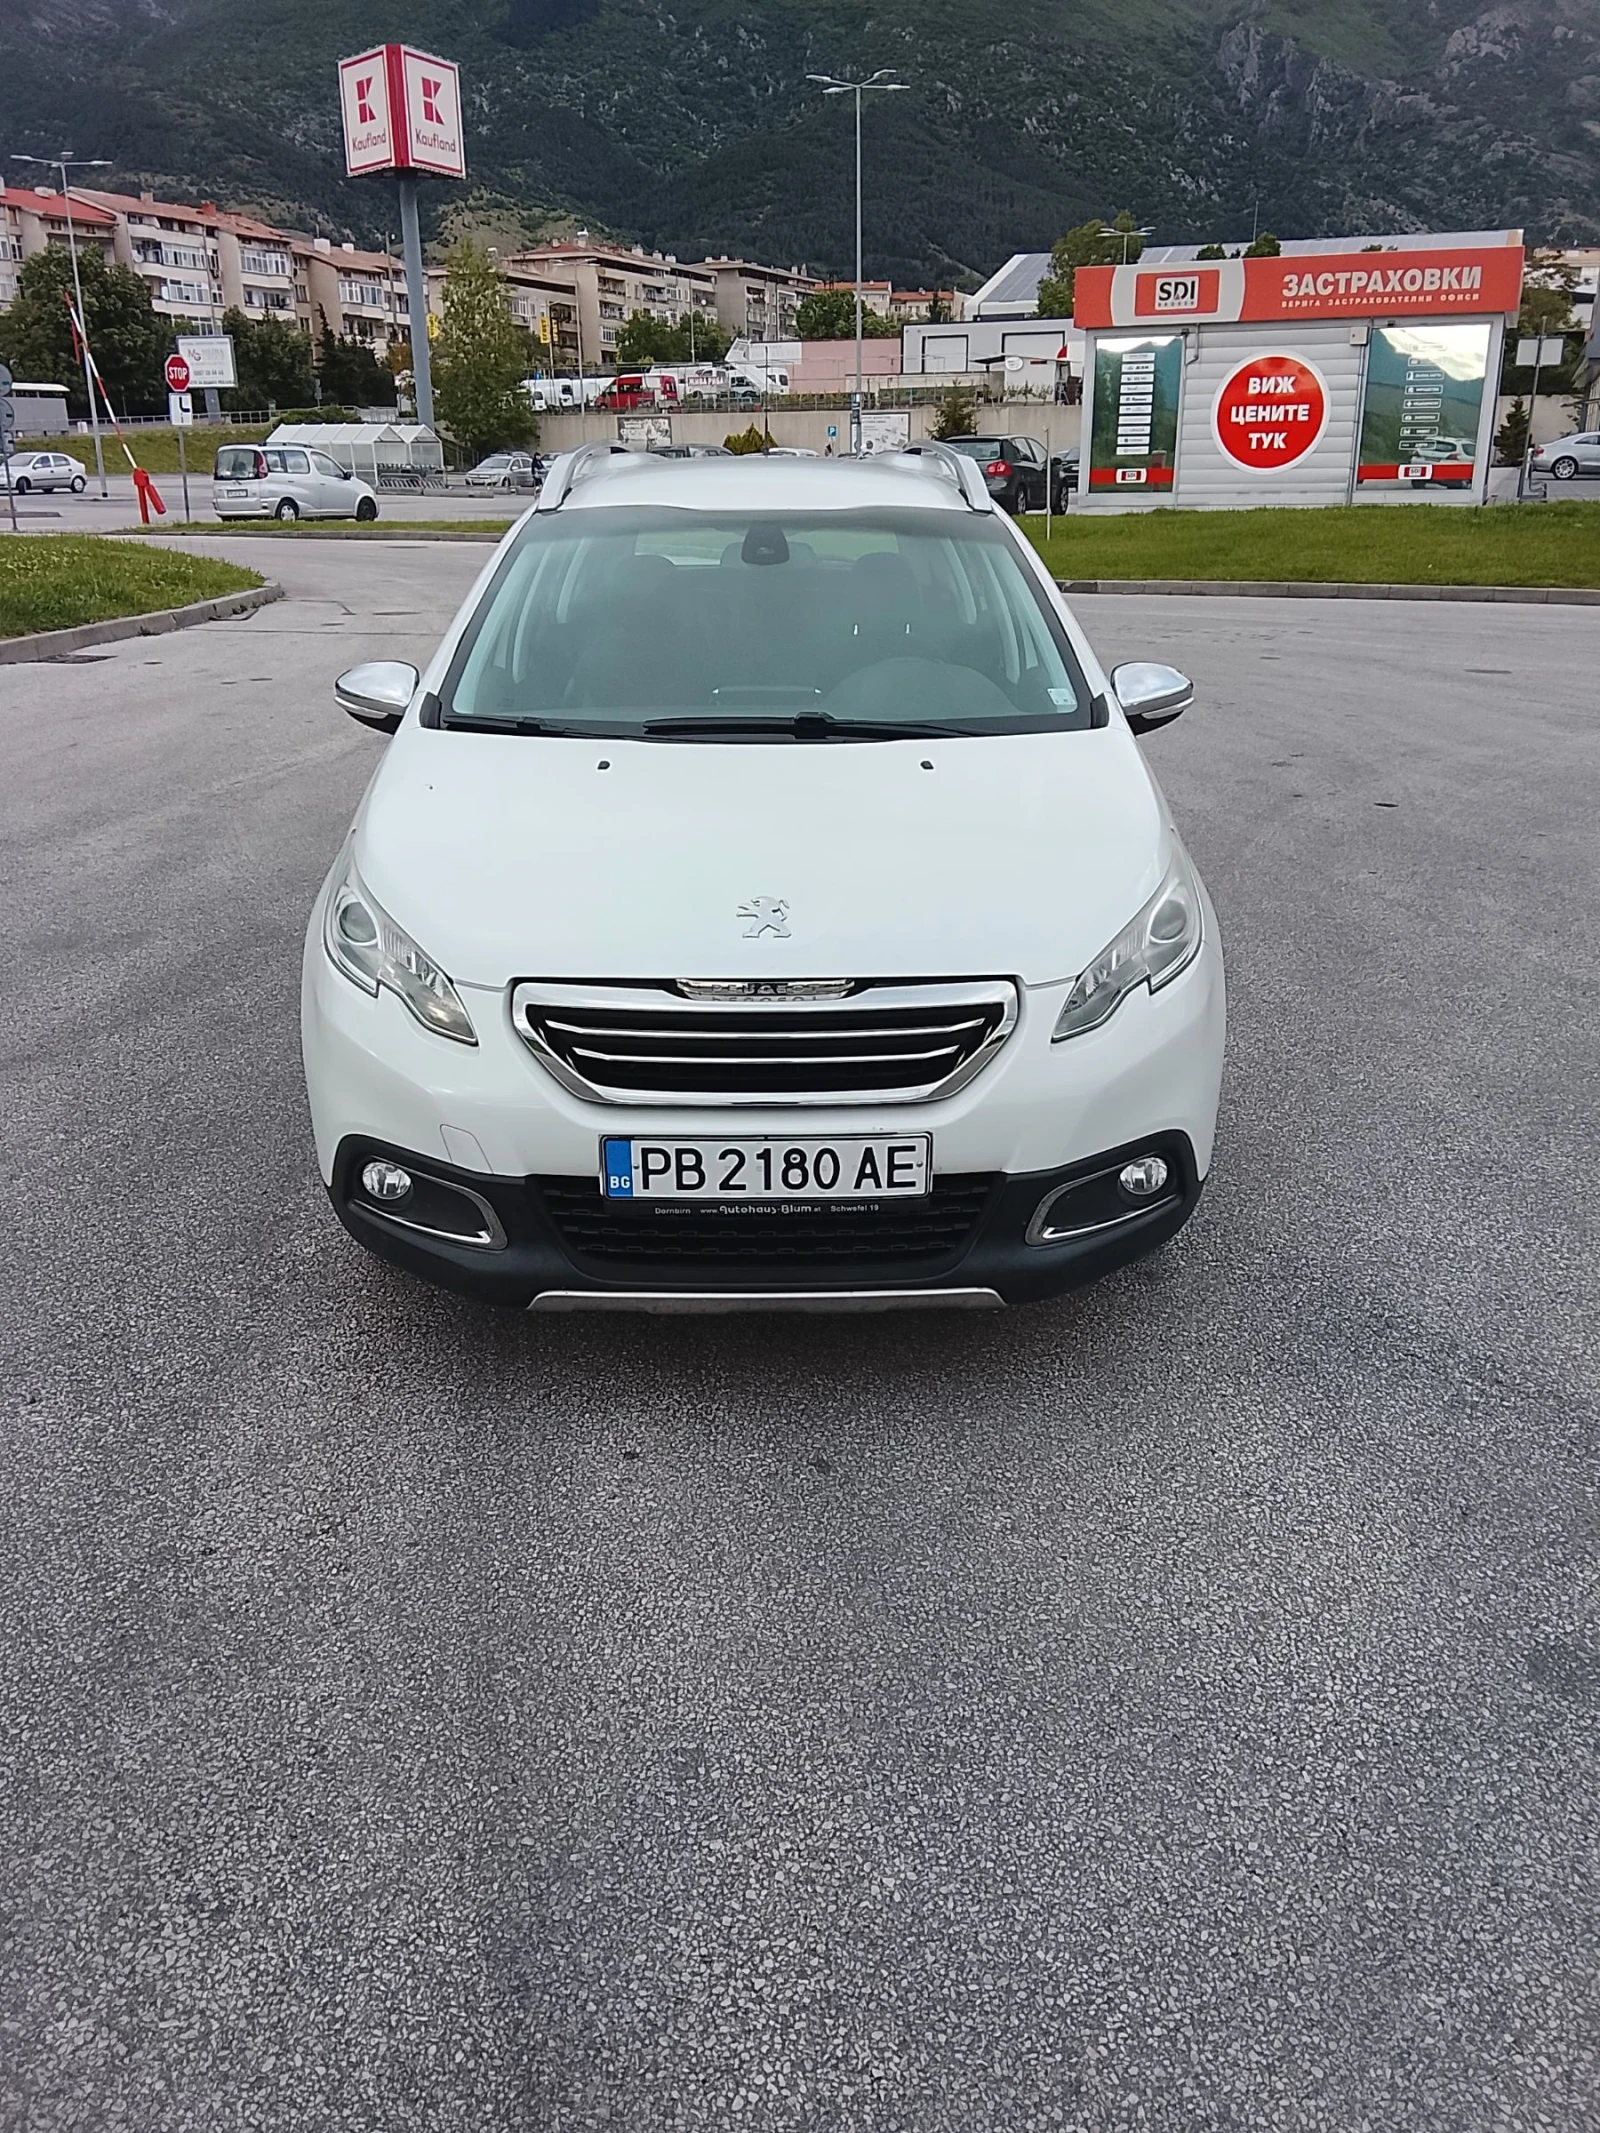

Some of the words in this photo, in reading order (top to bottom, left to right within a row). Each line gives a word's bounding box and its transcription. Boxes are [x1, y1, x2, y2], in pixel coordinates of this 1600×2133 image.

[352, 128, 387, 152] Kaufland
[415, 128, 456, 153] Kaufland
[1158, 280, 1196, 301] SDI
[1282, 266, 1482, 297] ЗАСТРАХОВКИ
[1281, 300, 1321, 308] ВЕРИГА
[1327, 295, 1433, 306] ЗАСТРАХОВАТЕЛНИ
[1440, 293, 1480, 302] ОФИСИ
[168, 366, 188, 380] STOP
[1248, 376, 1296, 394] ВИЖ
[1230, 404, 1310, 425] ЦЕНИТЕ
[1248, 432, 1288, 449] ТУК
[711, 983, 822, 995] PEUGEOT
[640, 1147, 706, 1191] PB
[718, 1147, 841, 1191] 2180
[853, 1145, 917, 1190] AE
[609, 1175, 631, 1189] BG
[655, 1207, 691, 1215] Dornbirn
[830, 1204, 868, 1213] Schwefel
[869, 1204, 879, 1212] 19
